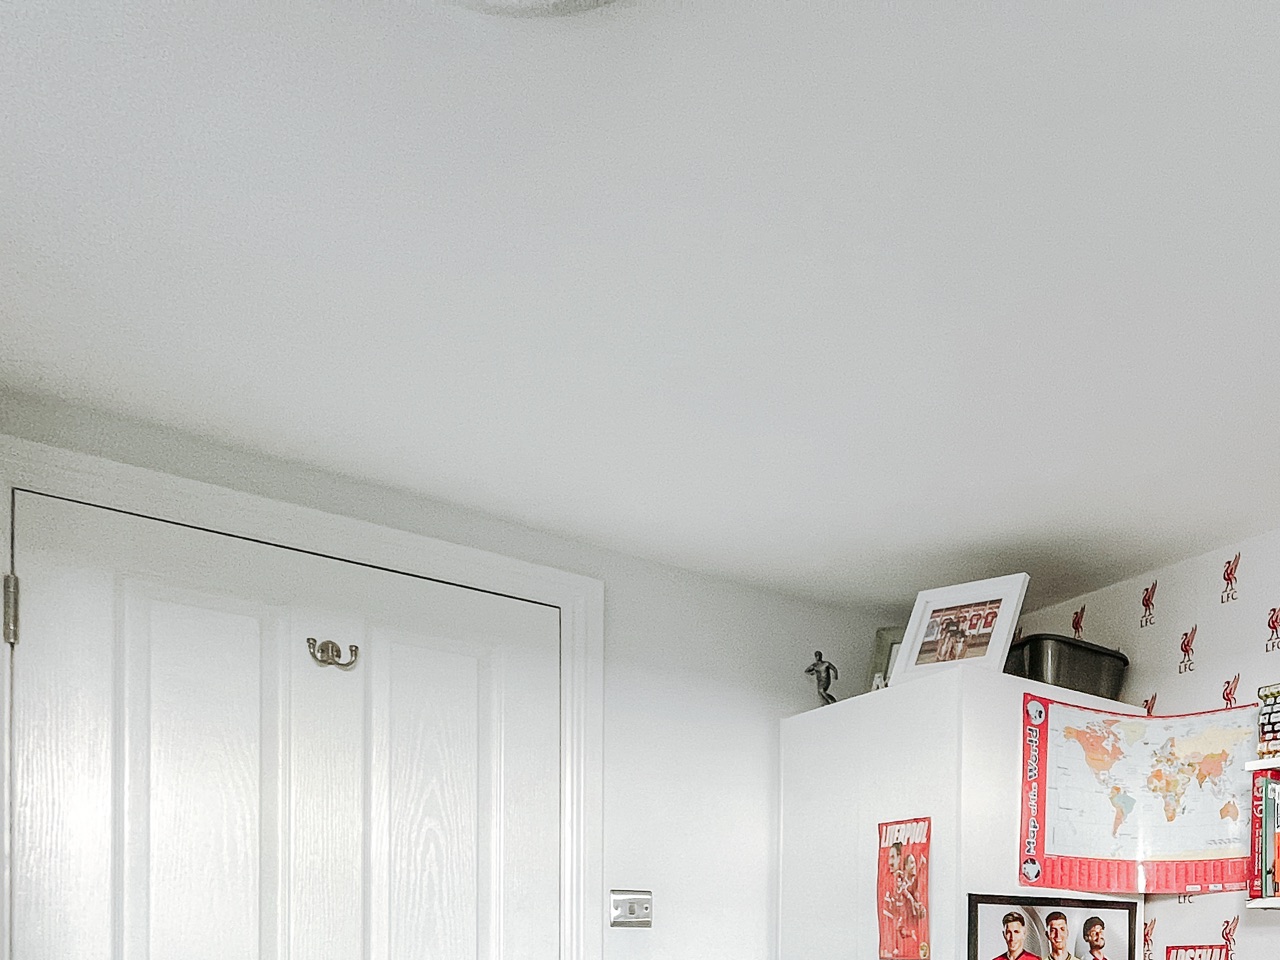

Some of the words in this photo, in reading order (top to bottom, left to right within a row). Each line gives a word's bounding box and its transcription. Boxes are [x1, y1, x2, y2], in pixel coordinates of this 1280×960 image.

[1026, 727, 1040, 781] World
[1029, 782, 1038, 802] the
[1030, 802, 1038, 816] of
[880, 819, 929, 849] LIVERPOOL
[1026, 819, 1040, 856] Map
